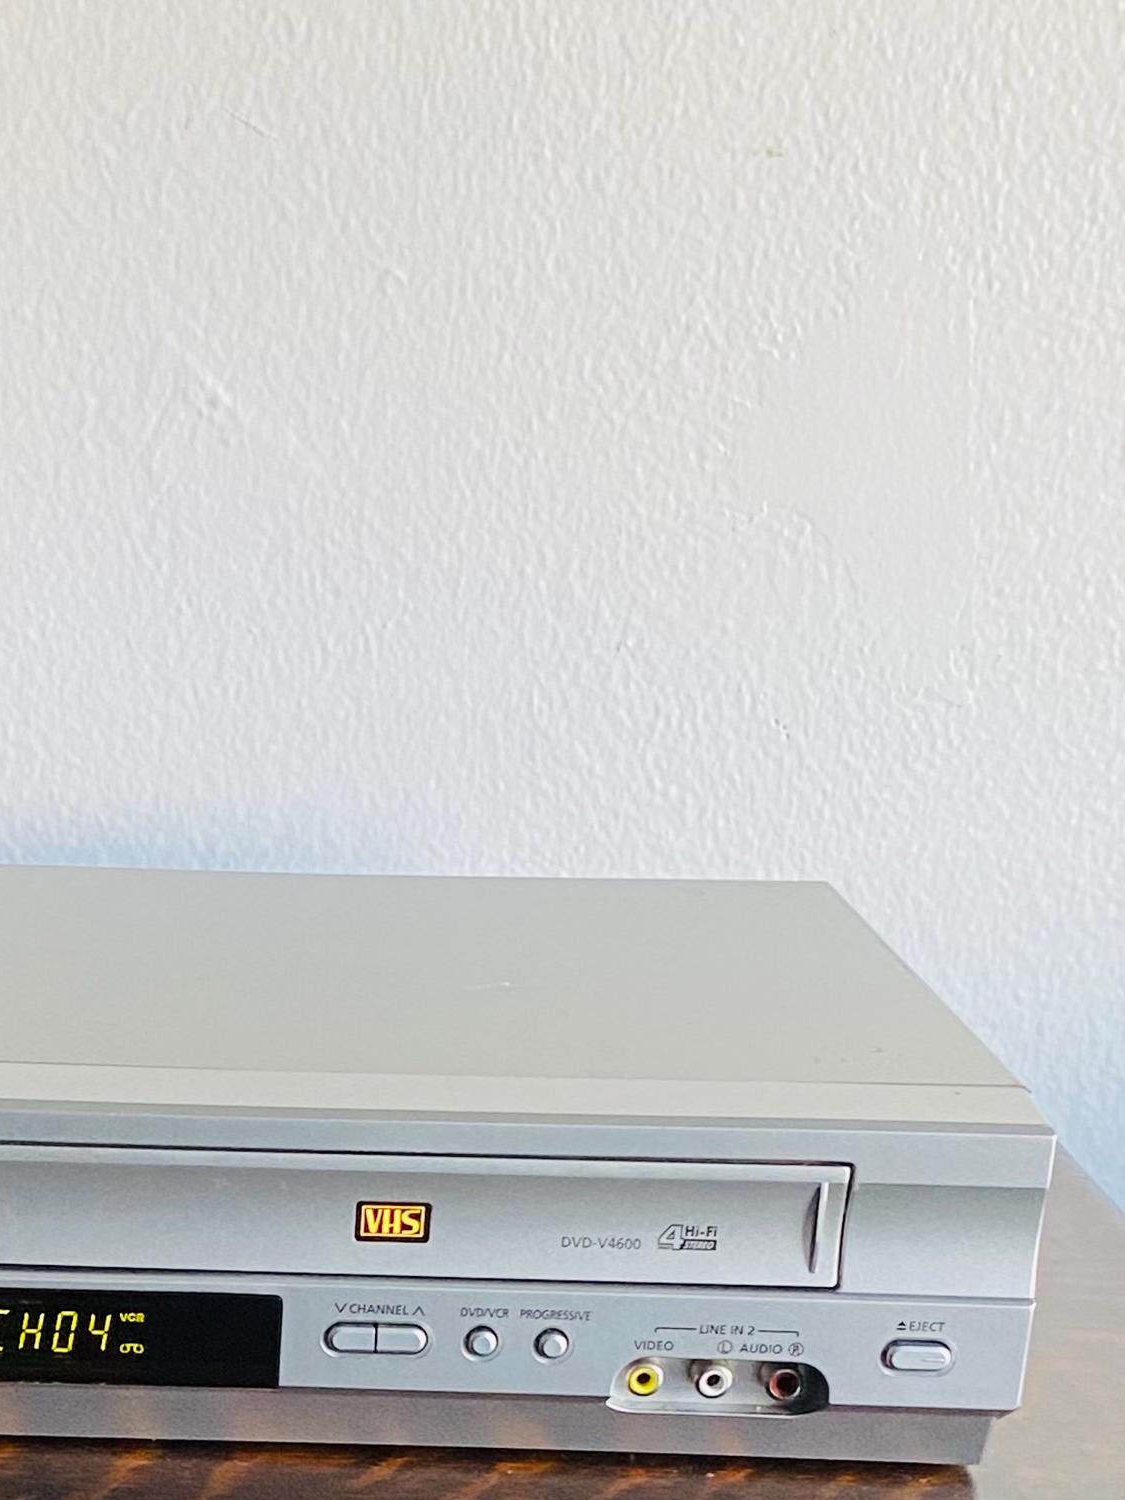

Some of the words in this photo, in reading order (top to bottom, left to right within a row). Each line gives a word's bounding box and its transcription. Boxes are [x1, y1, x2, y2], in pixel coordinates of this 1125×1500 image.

[365, 1207, 421, 1235] VHS
[685, 1225, 718, 1237] Hi-Fi
[561, 1236, 641, 1250] DVD-V4600
[349, 1303, 409, 1316] CHANNEL
[460, 1307, 509, 1319] DVD/VCR
[520, 1308, 592, 1321] PROGRESSIVE
[119, 1312, 145, 1323] VCR
[699, 1325, 726, 1335] LINE
[731, 1325, 744, 1336] IN
[748, 1325, 756, 1336] 2
[909, 1321, 946, 1333] EJECT
[634, 1340, 674, 1351] VIDEO
[740, 1343, 783, 1354] AUDIO
